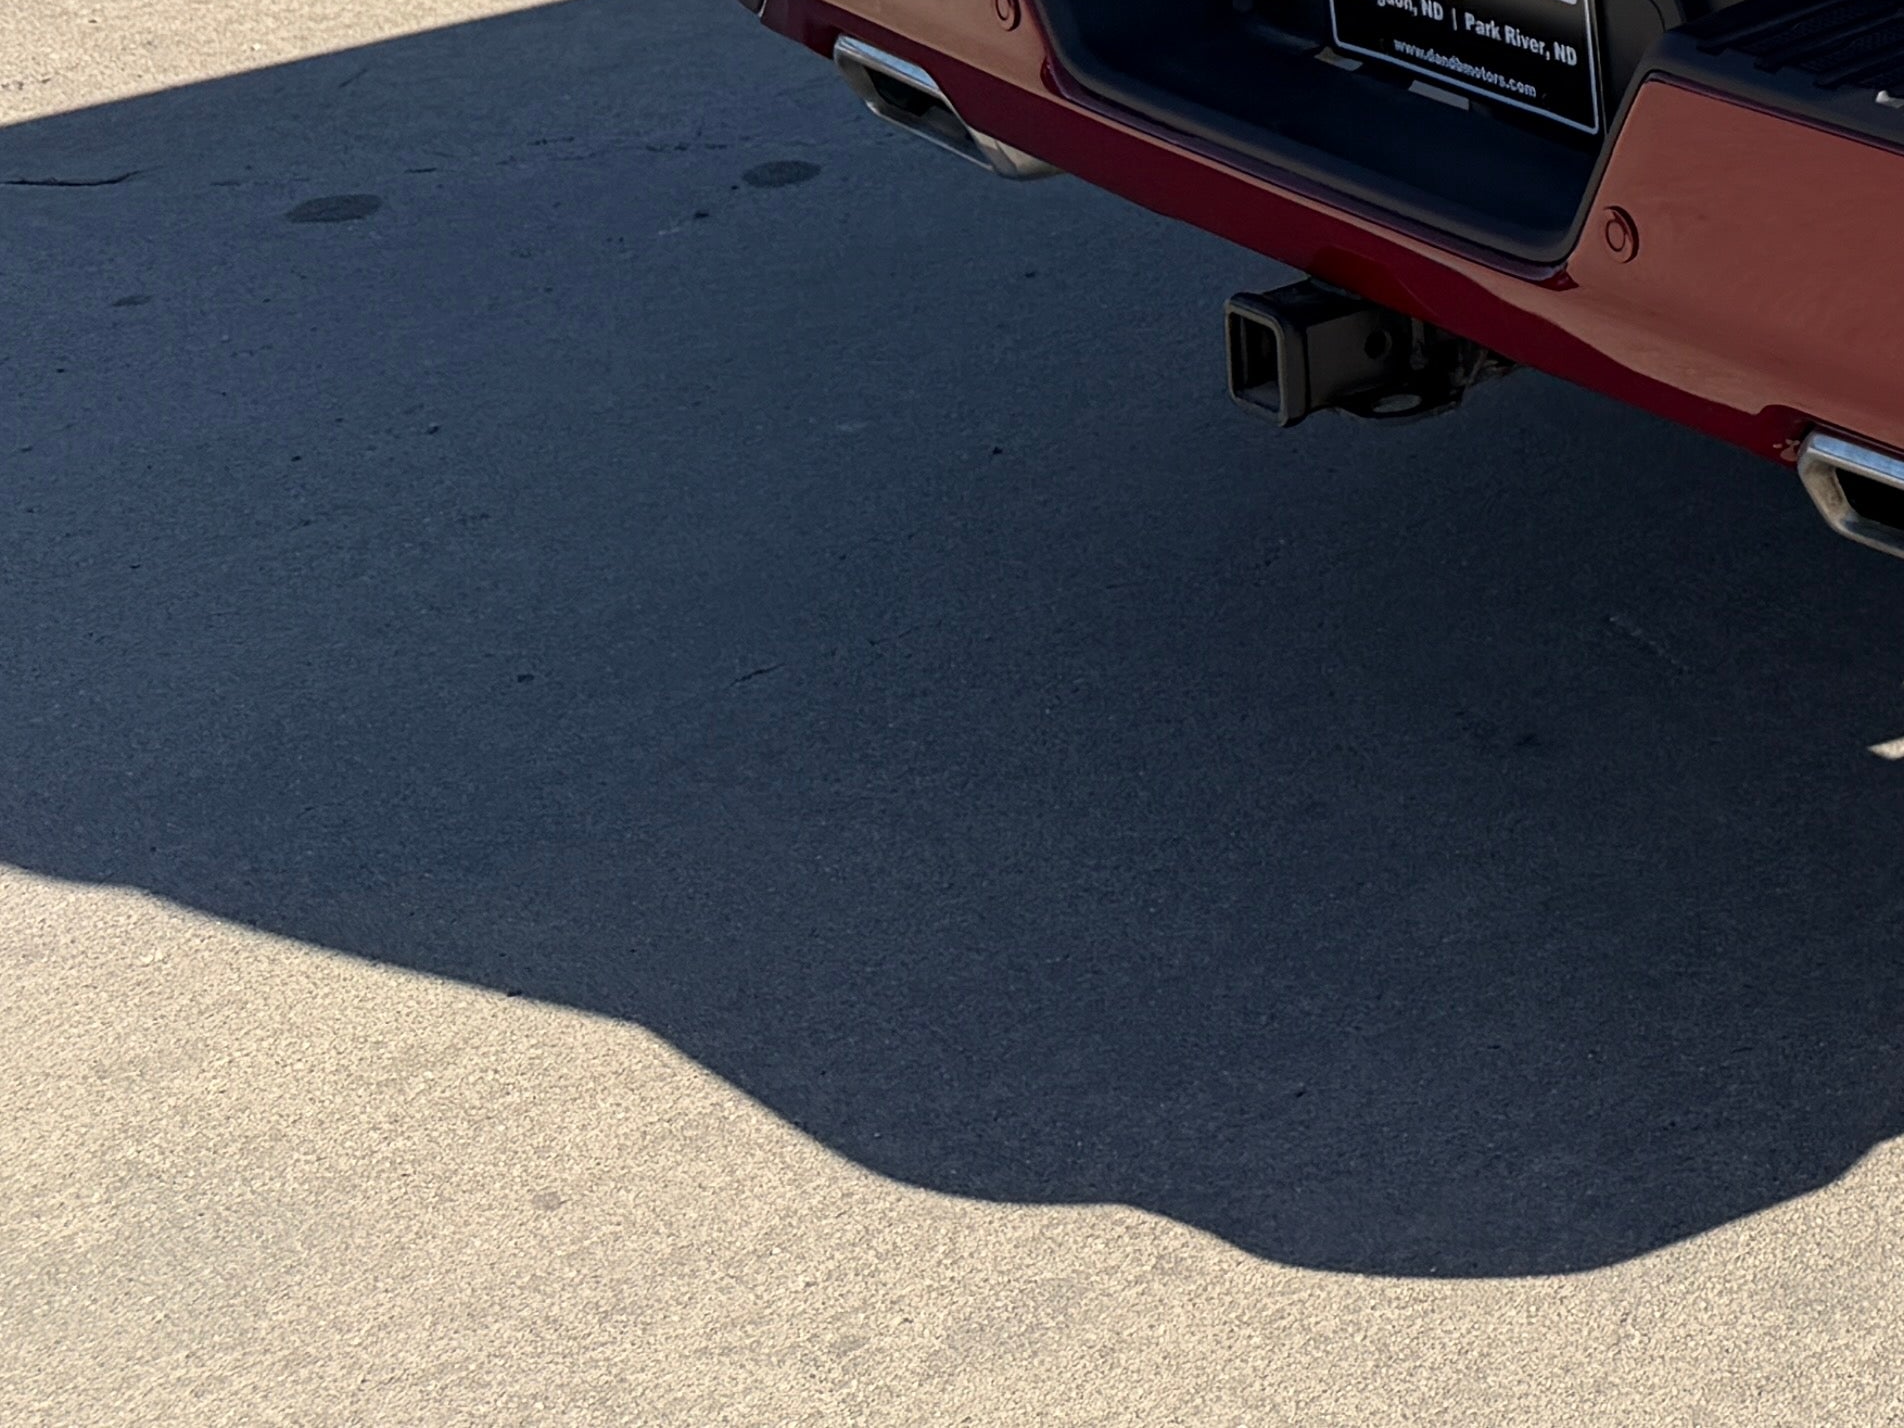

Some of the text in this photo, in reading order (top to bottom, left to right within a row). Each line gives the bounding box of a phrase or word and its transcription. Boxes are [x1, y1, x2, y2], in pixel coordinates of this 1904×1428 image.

[1464, 12, 1502, 40] Park
[1505, 25, 1551, 60] River,
[1554, 42, 1577, 66] ND
